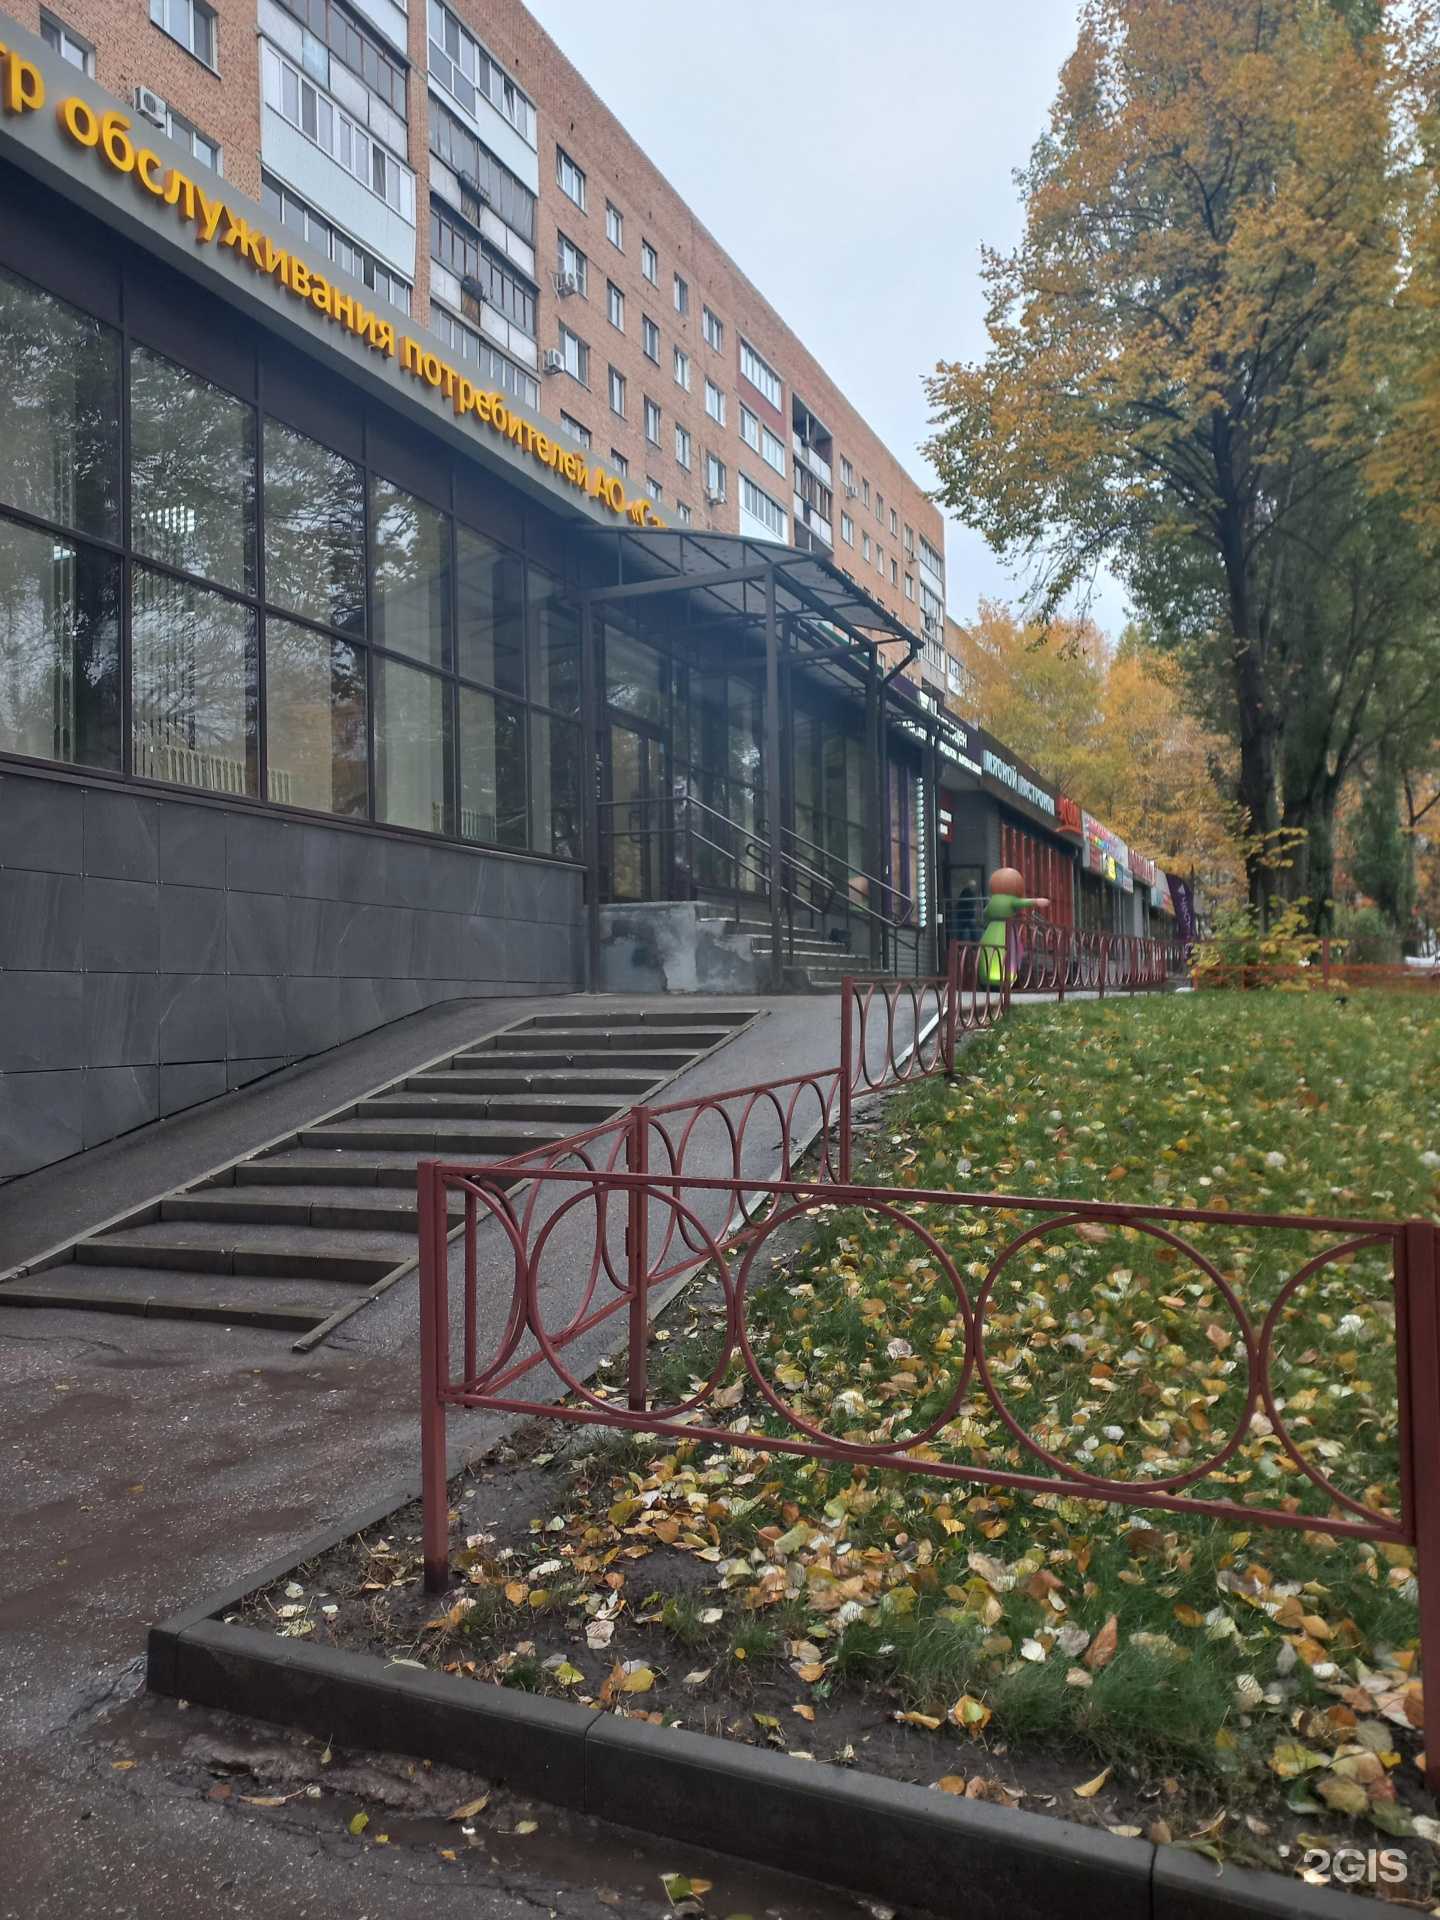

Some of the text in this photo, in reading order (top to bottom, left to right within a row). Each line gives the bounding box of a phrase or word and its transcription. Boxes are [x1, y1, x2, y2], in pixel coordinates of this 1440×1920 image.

[56, 96, 395, 359] обслуживания
[398, 335, 590, 492] потребителей
[590, 466, 626, 513] АО
[983, 749, 1018, 792] МЯСНОЙ
